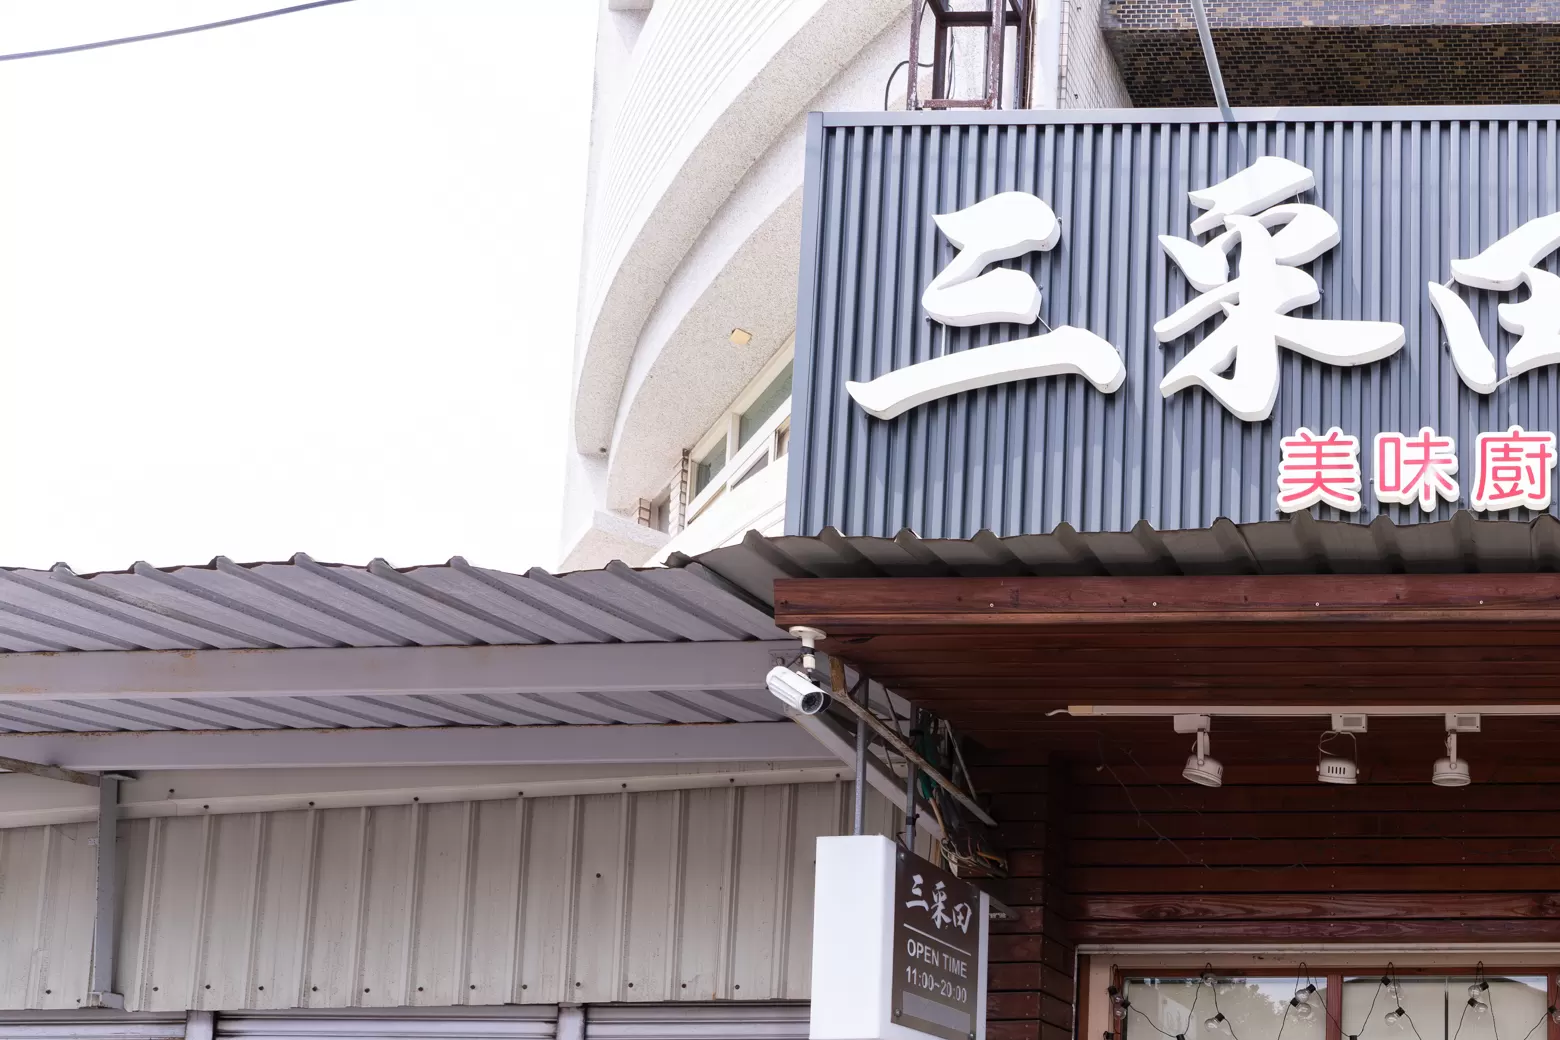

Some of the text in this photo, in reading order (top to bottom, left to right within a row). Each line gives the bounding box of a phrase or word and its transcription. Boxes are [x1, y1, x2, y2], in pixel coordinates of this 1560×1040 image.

[907, 938, 967, 979] OPEN TIME
[905, 965, 968, 1004] 11:00~20:00
